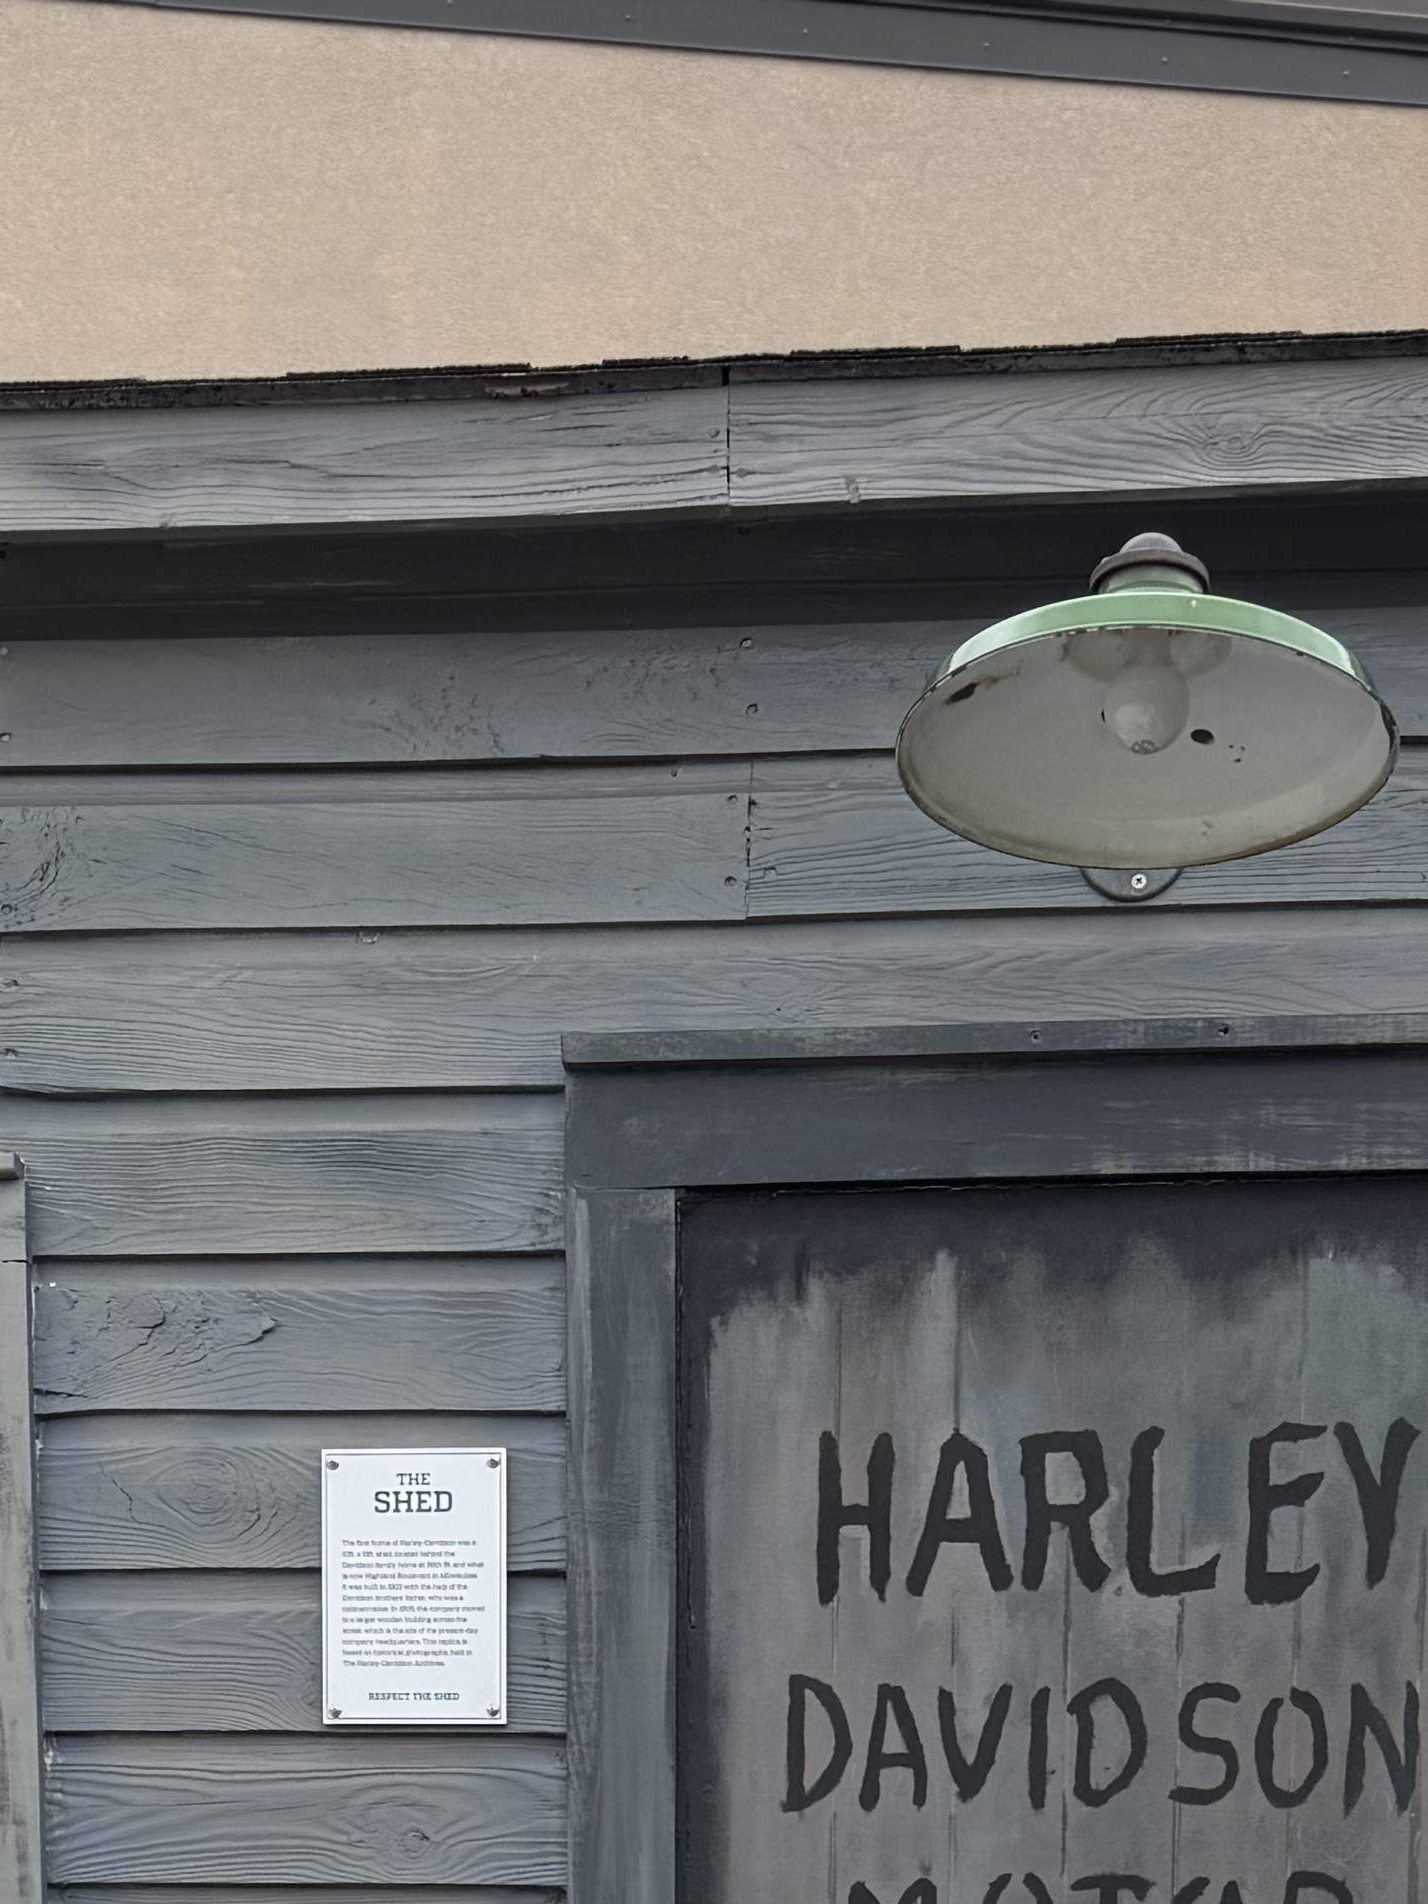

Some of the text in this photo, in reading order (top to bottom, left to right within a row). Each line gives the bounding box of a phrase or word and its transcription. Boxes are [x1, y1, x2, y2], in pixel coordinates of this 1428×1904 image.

[374, 1490, 453, 1513] SHED
[396, 1473, 431, 1486] THE
[815, 1416, 1421, 1606] HARLEY
[780, 1672, 1420, 1817] DAVIDSON
